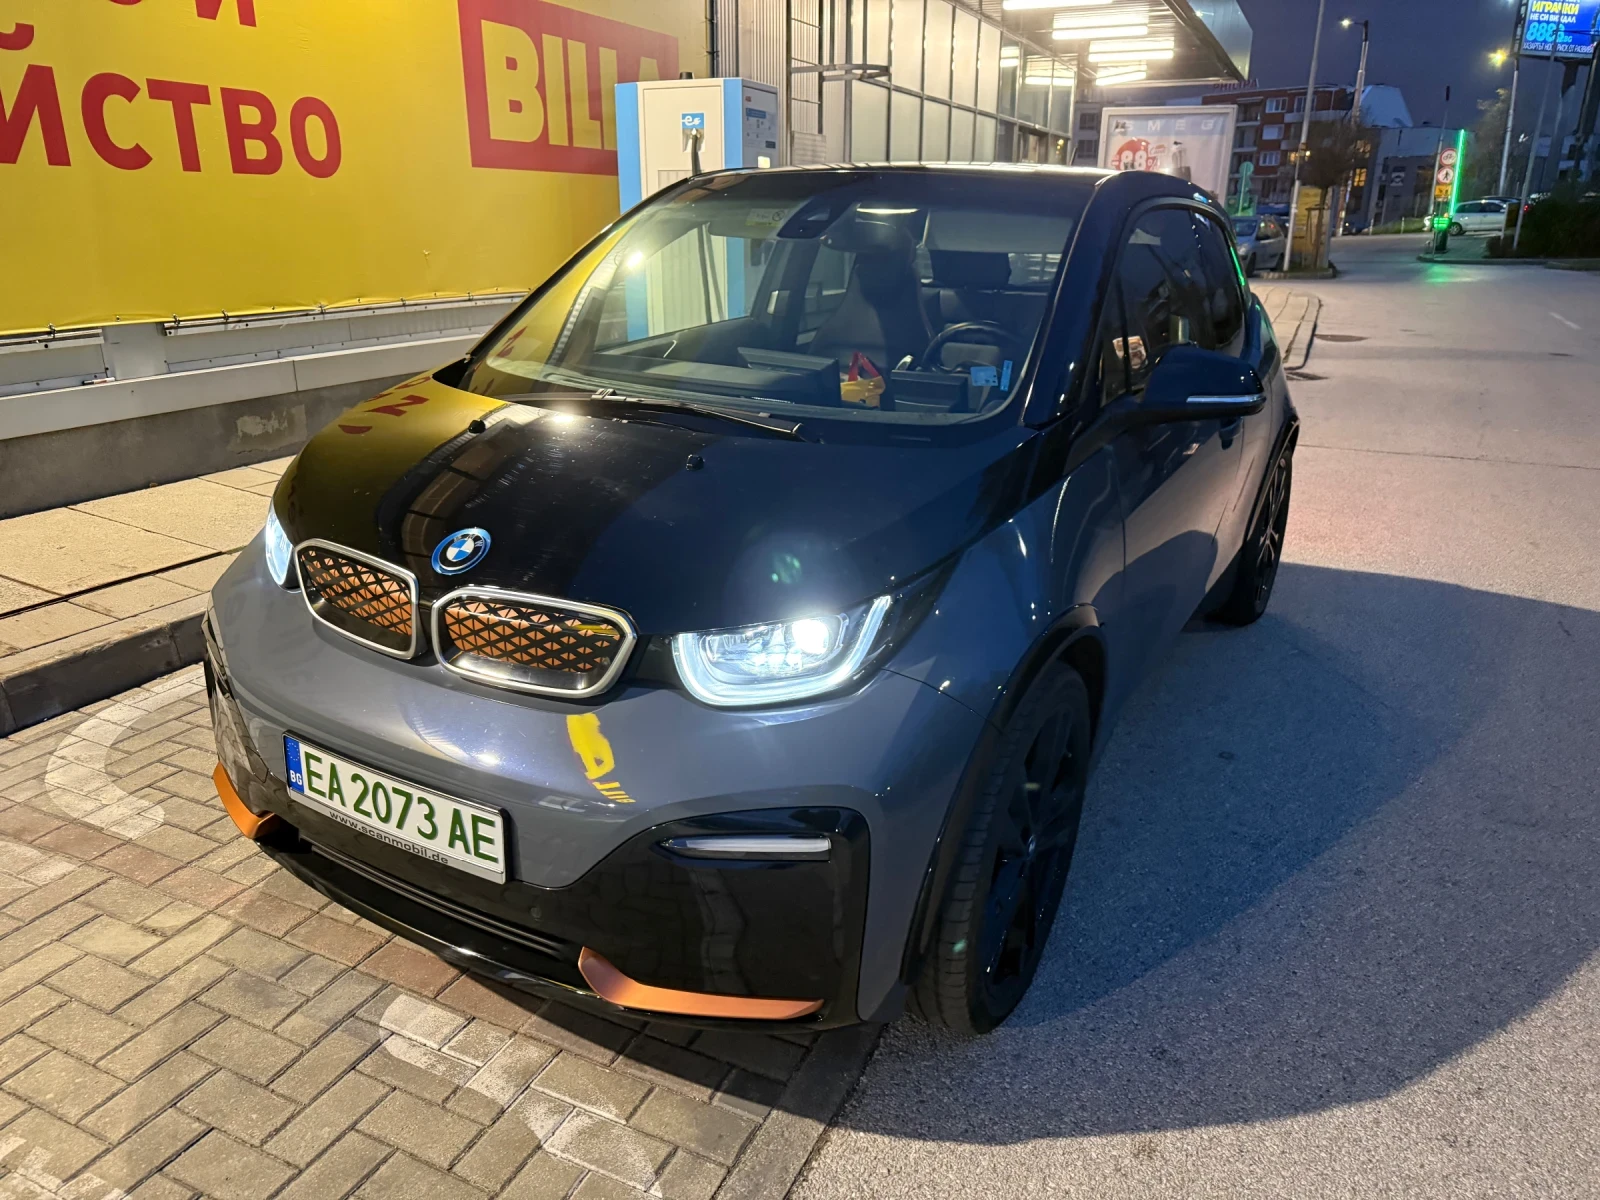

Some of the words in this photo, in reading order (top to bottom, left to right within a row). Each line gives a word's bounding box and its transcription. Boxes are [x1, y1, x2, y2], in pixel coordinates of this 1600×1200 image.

[1530, 13, 1539, 21] НЕ
[1540, 14, 1549, 22] СИ
[480, 19, 660, 151] BILL
[289, 769, 303, 786] BG
[329, 811, 448, 864] www.scanmobil.de
